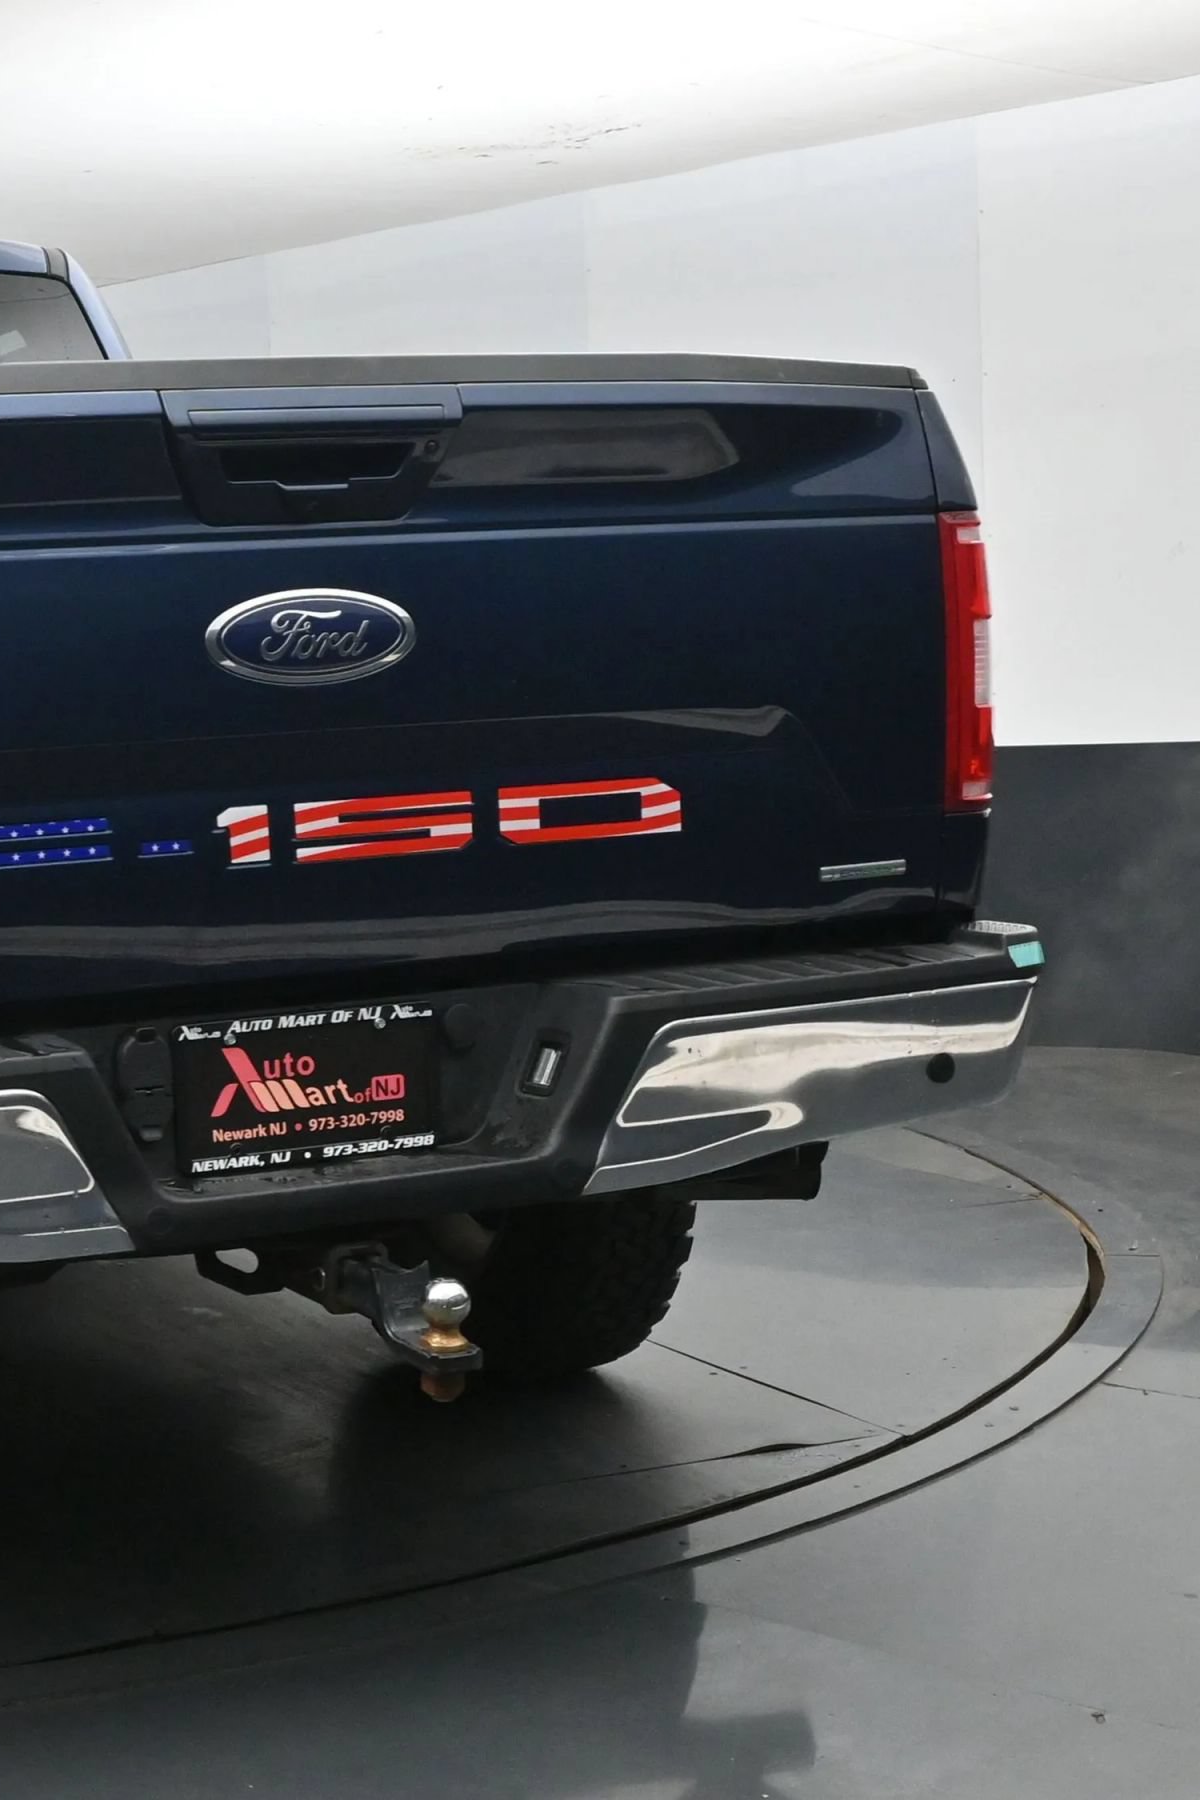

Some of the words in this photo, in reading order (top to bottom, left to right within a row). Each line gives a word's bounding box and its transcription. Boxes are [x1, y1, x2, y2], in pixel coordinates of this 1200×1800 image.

[260, 609, 370, 662] Ford
[356, 1005, 382, 1021] NJ
[211, 1047, 316, 1117] Auto
[354, 1089, 373, 1104] of
[374, 1077, 402, 1099] NJ
[212, 1122, 267, 1143] Newark
[269, 1120, 287, 1136] NJ
[308, 1108, 405, 1132] 973-320-7998
[191, 1153, 265, 1173] NEWARK,
[269, 1151, 291, 1164] NJ
[322, 1134, 435, 1158] 973-320-7998
